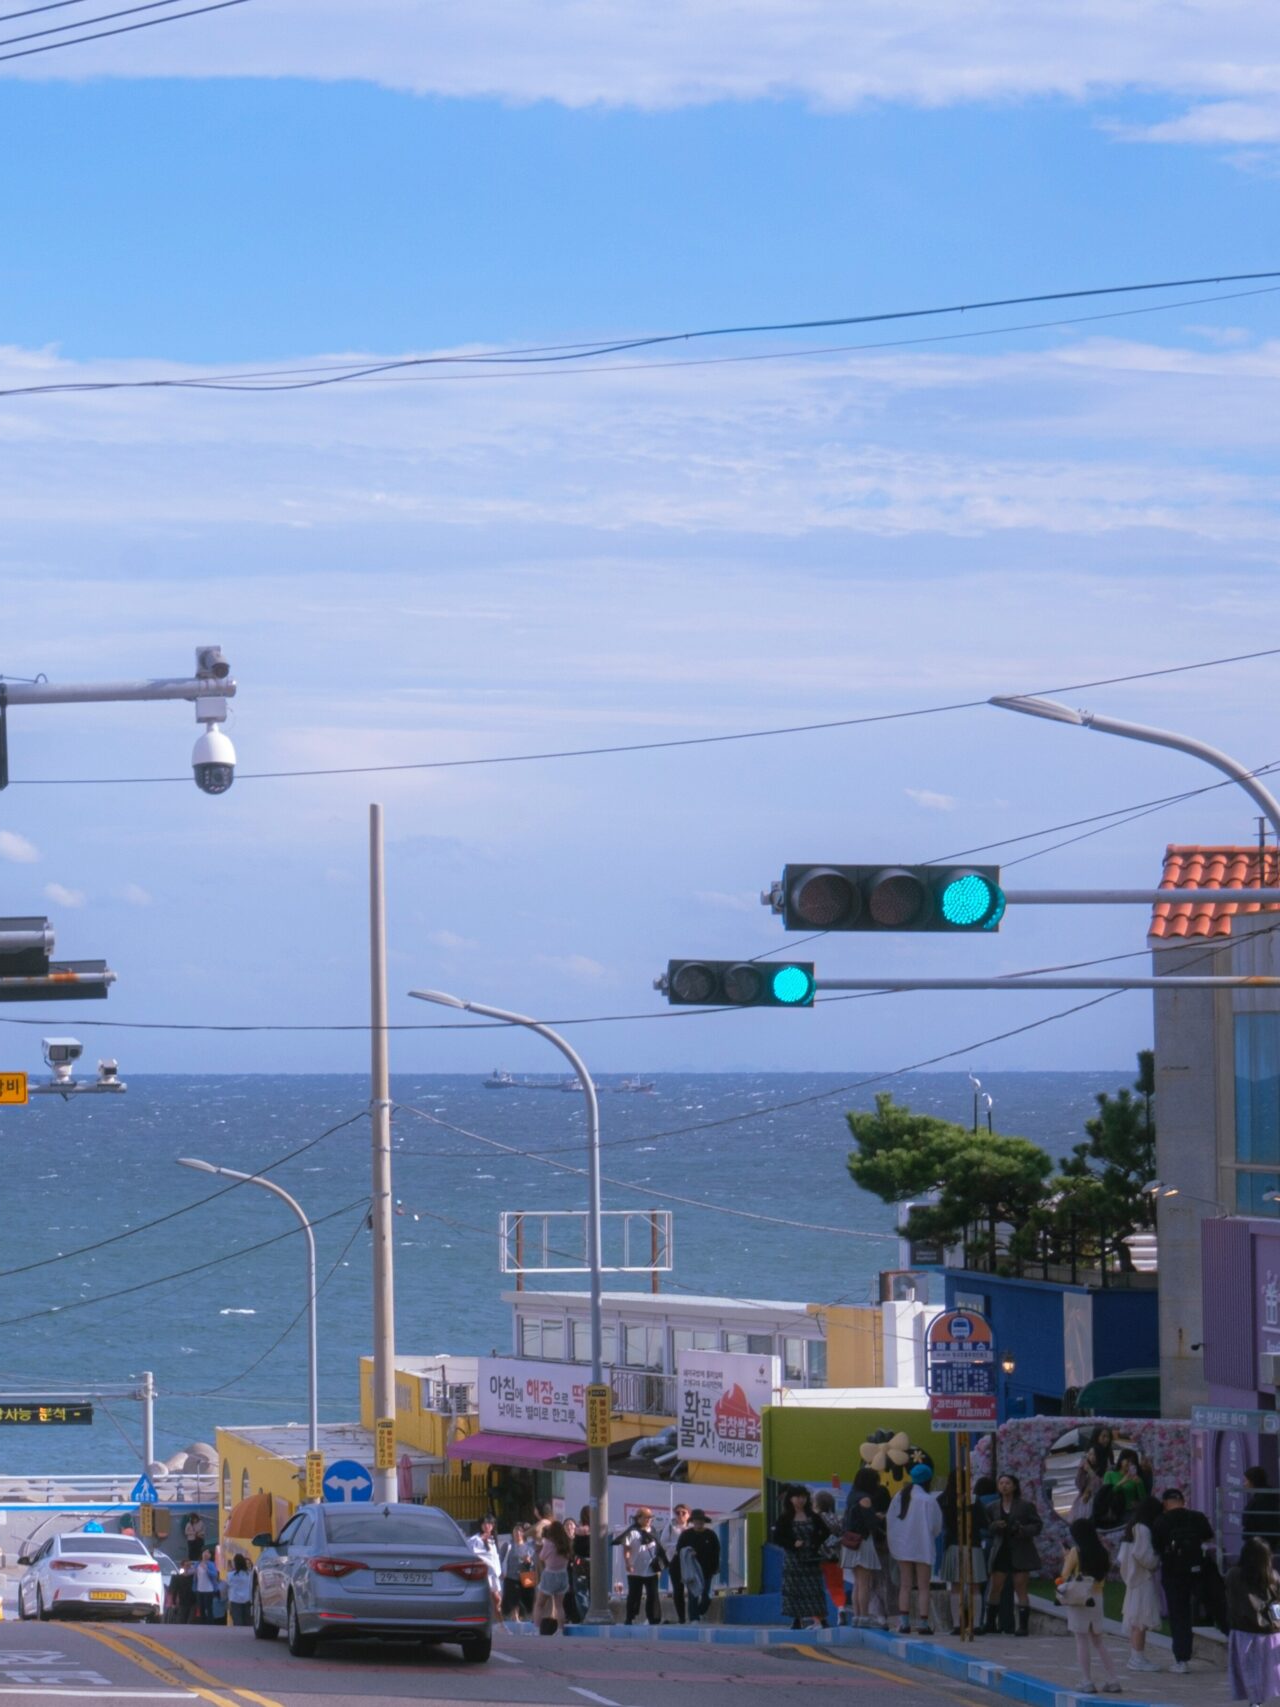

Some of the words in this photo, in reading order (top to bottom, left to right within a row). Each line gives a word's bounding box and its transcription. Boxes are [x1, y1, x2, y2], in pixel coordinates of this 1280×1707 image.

[490, 1376, 524, 1402] 아침에
[526, 1379, 569, 1406] 해장으로
[684, 1390, 711, 1419] 화끈
[39, 1407, 66, 1422] 분석
[498, 1402, 523, 1418] 낮에는
[525, 1406, 550, 1420] 별미로
[680, 1416, 715, 1449] 불맛!
